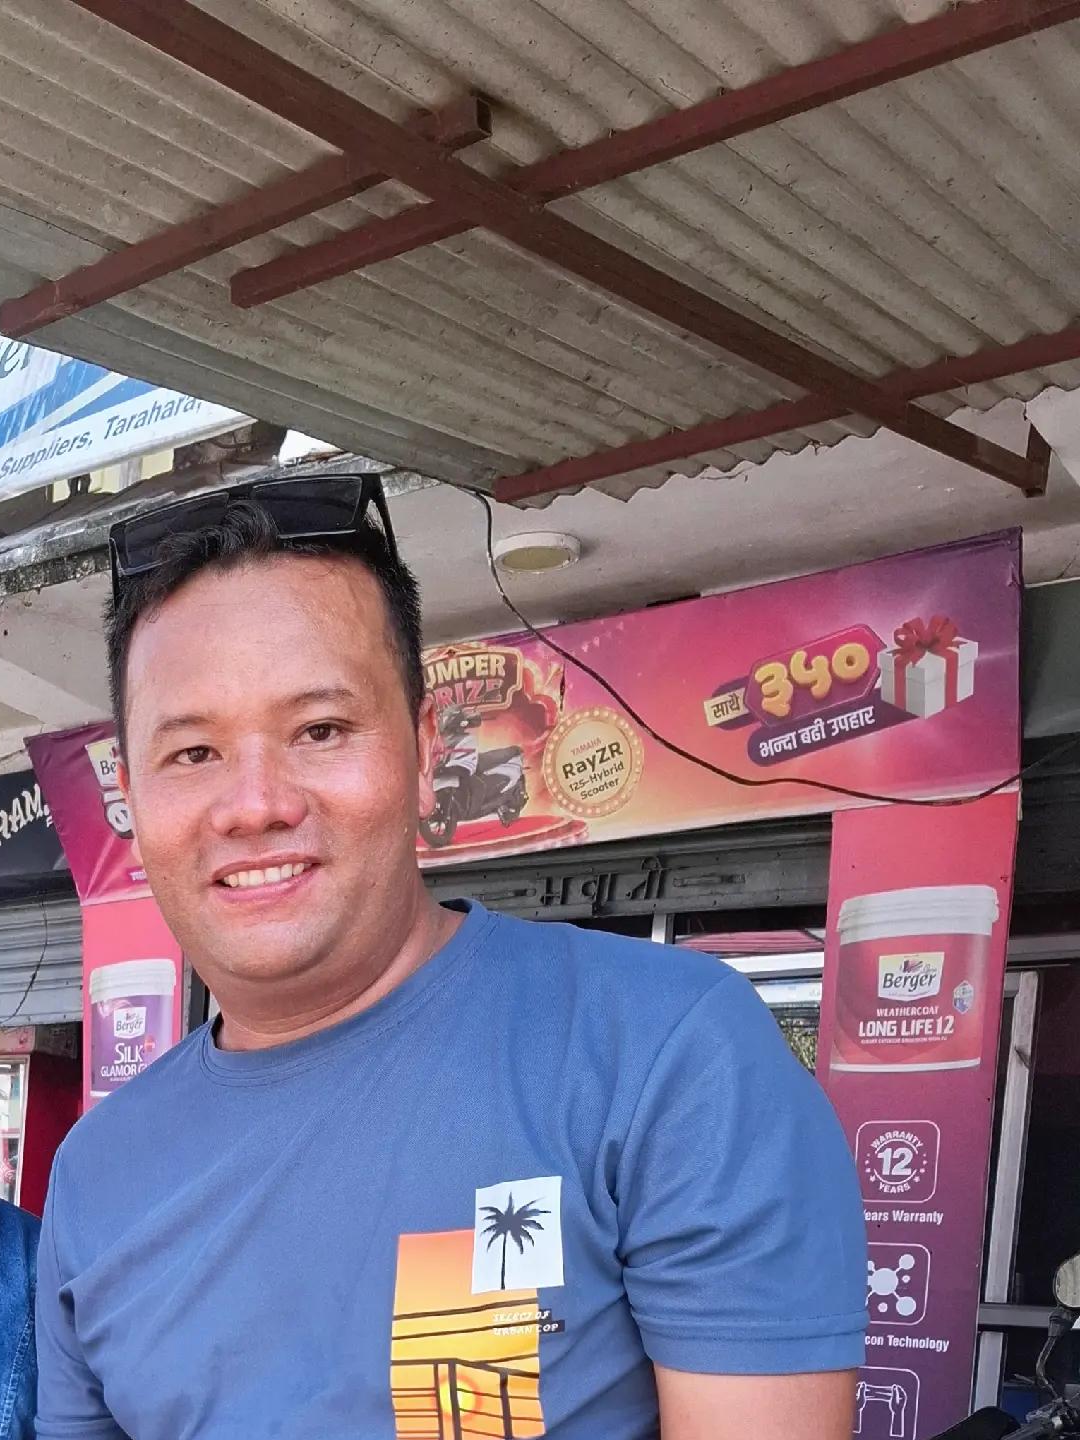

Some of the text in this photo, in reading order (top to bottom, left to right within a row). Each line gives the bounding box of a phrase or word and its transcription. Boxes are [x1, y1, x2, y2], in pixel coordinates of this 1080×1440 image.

[424, 654, 506, 689] UMPER
[426, 679, 504, 711] RIZE
[759, 732, 798, 757] भन्दा
[827, 706, 876, 736] उपहार
[562, 741, 624, 779] RayZR
[580, 778, 620, 800] Scooter
[883, 972, 937, 992] Berger
[876, 1006, 939, 1017] WEATHERCOAT
[859, 1015, 955, 1037] LONG LIFE 12
[101, 1064, 137, 1077] GLAMOR
[870, 1130, 923, 1149] WARRANTY
[877, 1147, 913, 1175] 12
[879, 1182, 911, 1193] YEARS
[863, 1209, 944, 1225] ears Warranty
[887, 1334, 950, 1352] Technology
